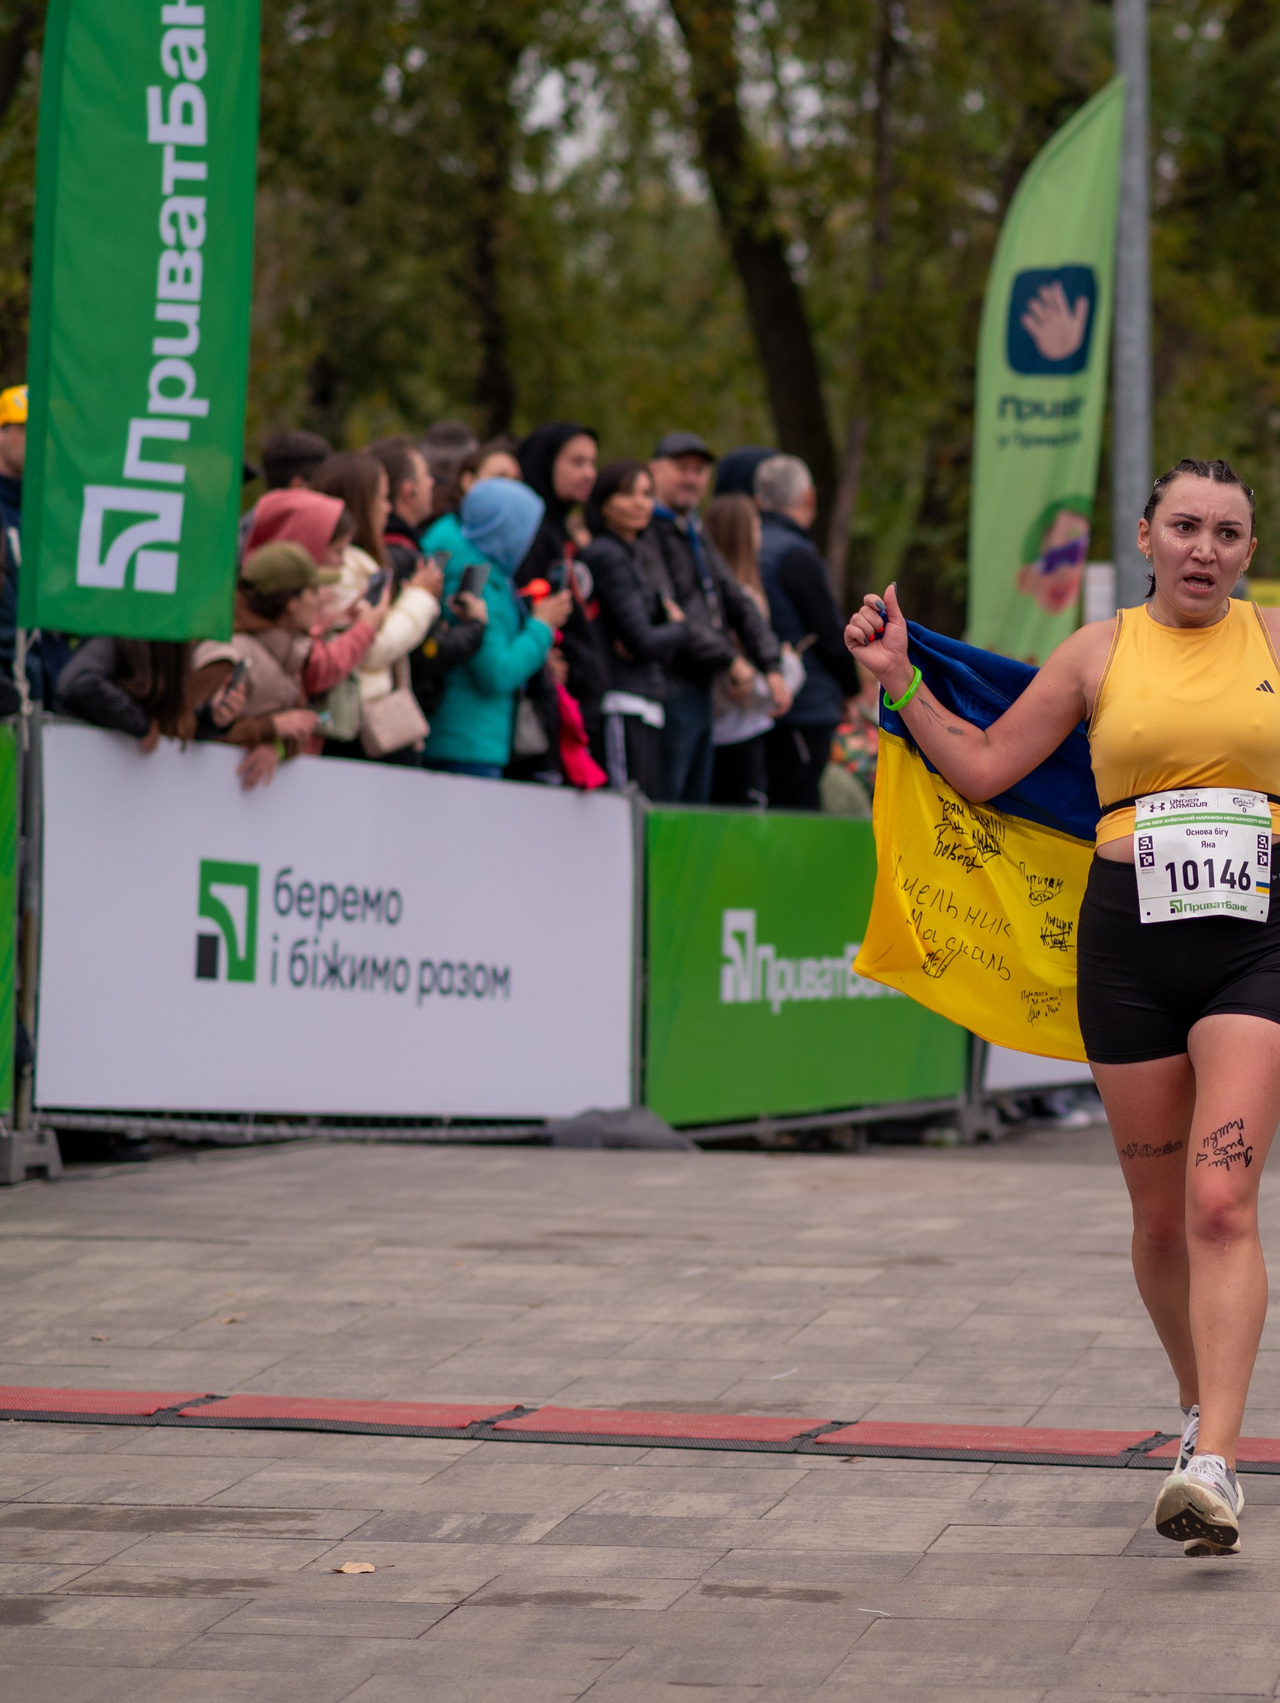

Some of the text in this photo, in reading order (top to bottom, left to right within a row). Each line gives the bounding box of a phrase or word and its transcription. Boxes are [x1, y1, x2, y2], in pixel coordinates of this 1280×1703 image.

[1170, 801, 1208, 810] ARMOUR
[1186, 827, 1229, 838] Основа бігу
[1201, 840, 1216, 849] Яна
[1165, 858, 1251, 893] 10146
[273, 866, 404, 932] беремо
[1183, 900, 1248, 913] ПриватБанк
[270, 934, 510, 1008] і біжимо разом
[756, 943, 907, 1016] ПриватБ
